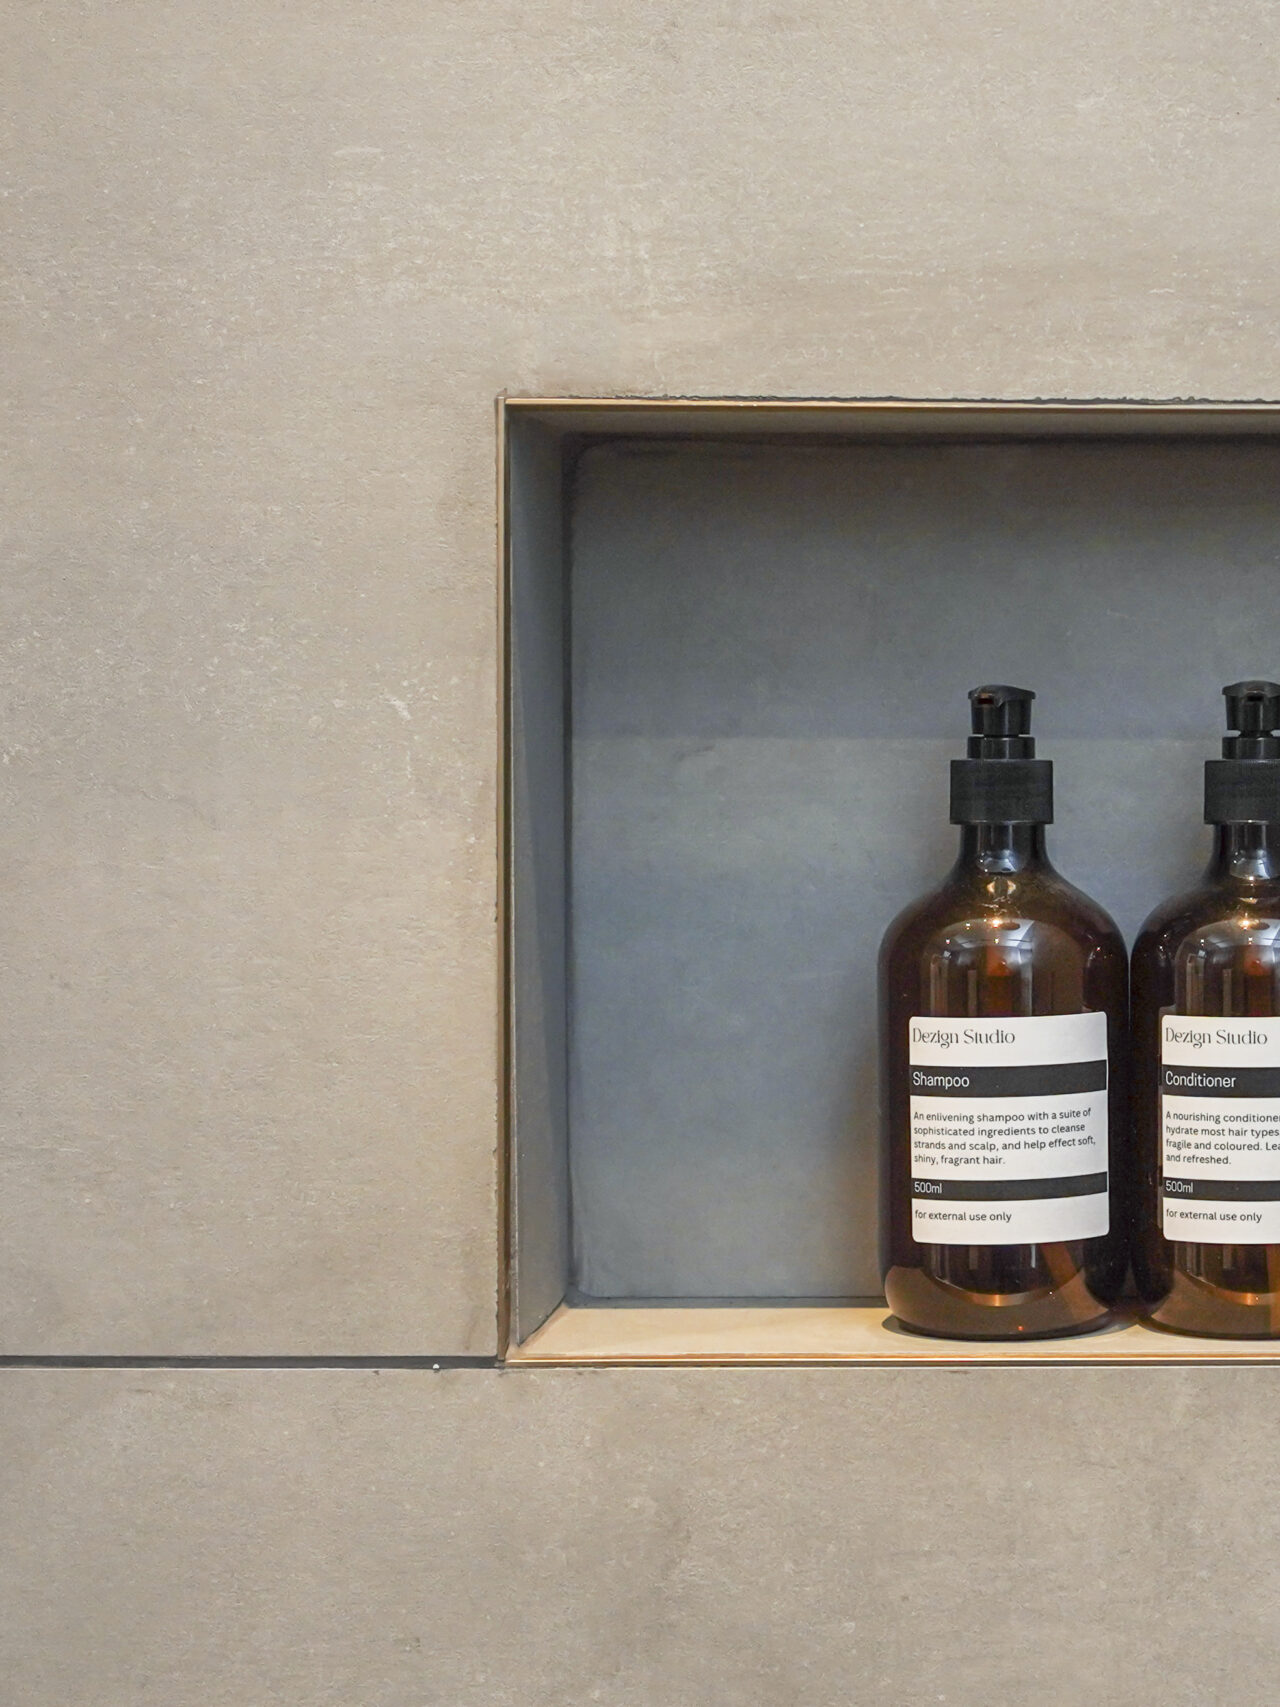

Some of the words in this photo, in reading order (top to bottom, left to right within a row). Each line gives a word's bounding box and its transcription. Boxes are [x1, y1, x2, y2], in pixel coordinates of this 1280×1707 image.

[913, 1028, 959, 1048] Dezign
[963, 1029, 1015, 1044] Studio
[1166, 1027, 1211, 1048] Dezign
[1216, 1029, 1268, 1045] Studio
[912, 1072, 970, 1089] Shampoo
[1166, 1071, 1236, 1087] Conditioner
[914, 1112, 924, 1120] An
[926, 1112, 974, 1124] enlivening
[977, 1113, 1024, 1124] shampoo
[1028, 1112, 1048, 1121] with
[1059, 1110, 1080, 1119] suite
[1083, 1108, 1091, 1117] of
[1173, 1112, 1220, 1124] nourishing
[914, 1126, 974, 1136] sophisticated
[978, 1127, 1036, 1138] ingredients
[1038, 1126, 1048, 1134] to
[1051, 1124, 1085, 1134] cleanse
[1166, 1126, 1198, 1136] hydrate
[1201, 1128, 1225, 1136] most
[1228, 1127, 1247, 1136] hair
[914, 1141, 945, 1150] strands
[948, 1142, 966, 1150] and
[969, 1141, 998, 1152] scalp,
[1002, 1141, 1021, 1150] and
[1024, 1140, 1046, 1151] help
[1049, 1138, 1075, 1148] effect
[1078, 1136, 1095, 1146] soft,
[1166, 1140, 1192, 1150] fragile
[1194, 1141, 1211, 1150] and
[1214, 1142, 1262, 1151] coloured.
[914, 1155, 938, 1165] shiny,
[941, 1155, 980, 1166] fragrant
[983, 1156, 1005, 1164] hair.
[1166, 1154, 1180, 1162] and
[1183, 1155, 1231, 1165] refreshed.
[914, 1182, 942, 1194] 500ml
[1166, 1181, 1193, 1193] 500ml
[915, 1210, 926, 1219] for
[929, 1211, 966, 1221] external
[969, 1213, 987, 1221] use
[990, 1212, 1012, 1223] only
[1166, 1209, 1177, 1218] for
[1180, 1210, 1216, 1221] external
[1220, 1213, 1237, 1221] use
[1240, 1212, 1262, 1223] only
